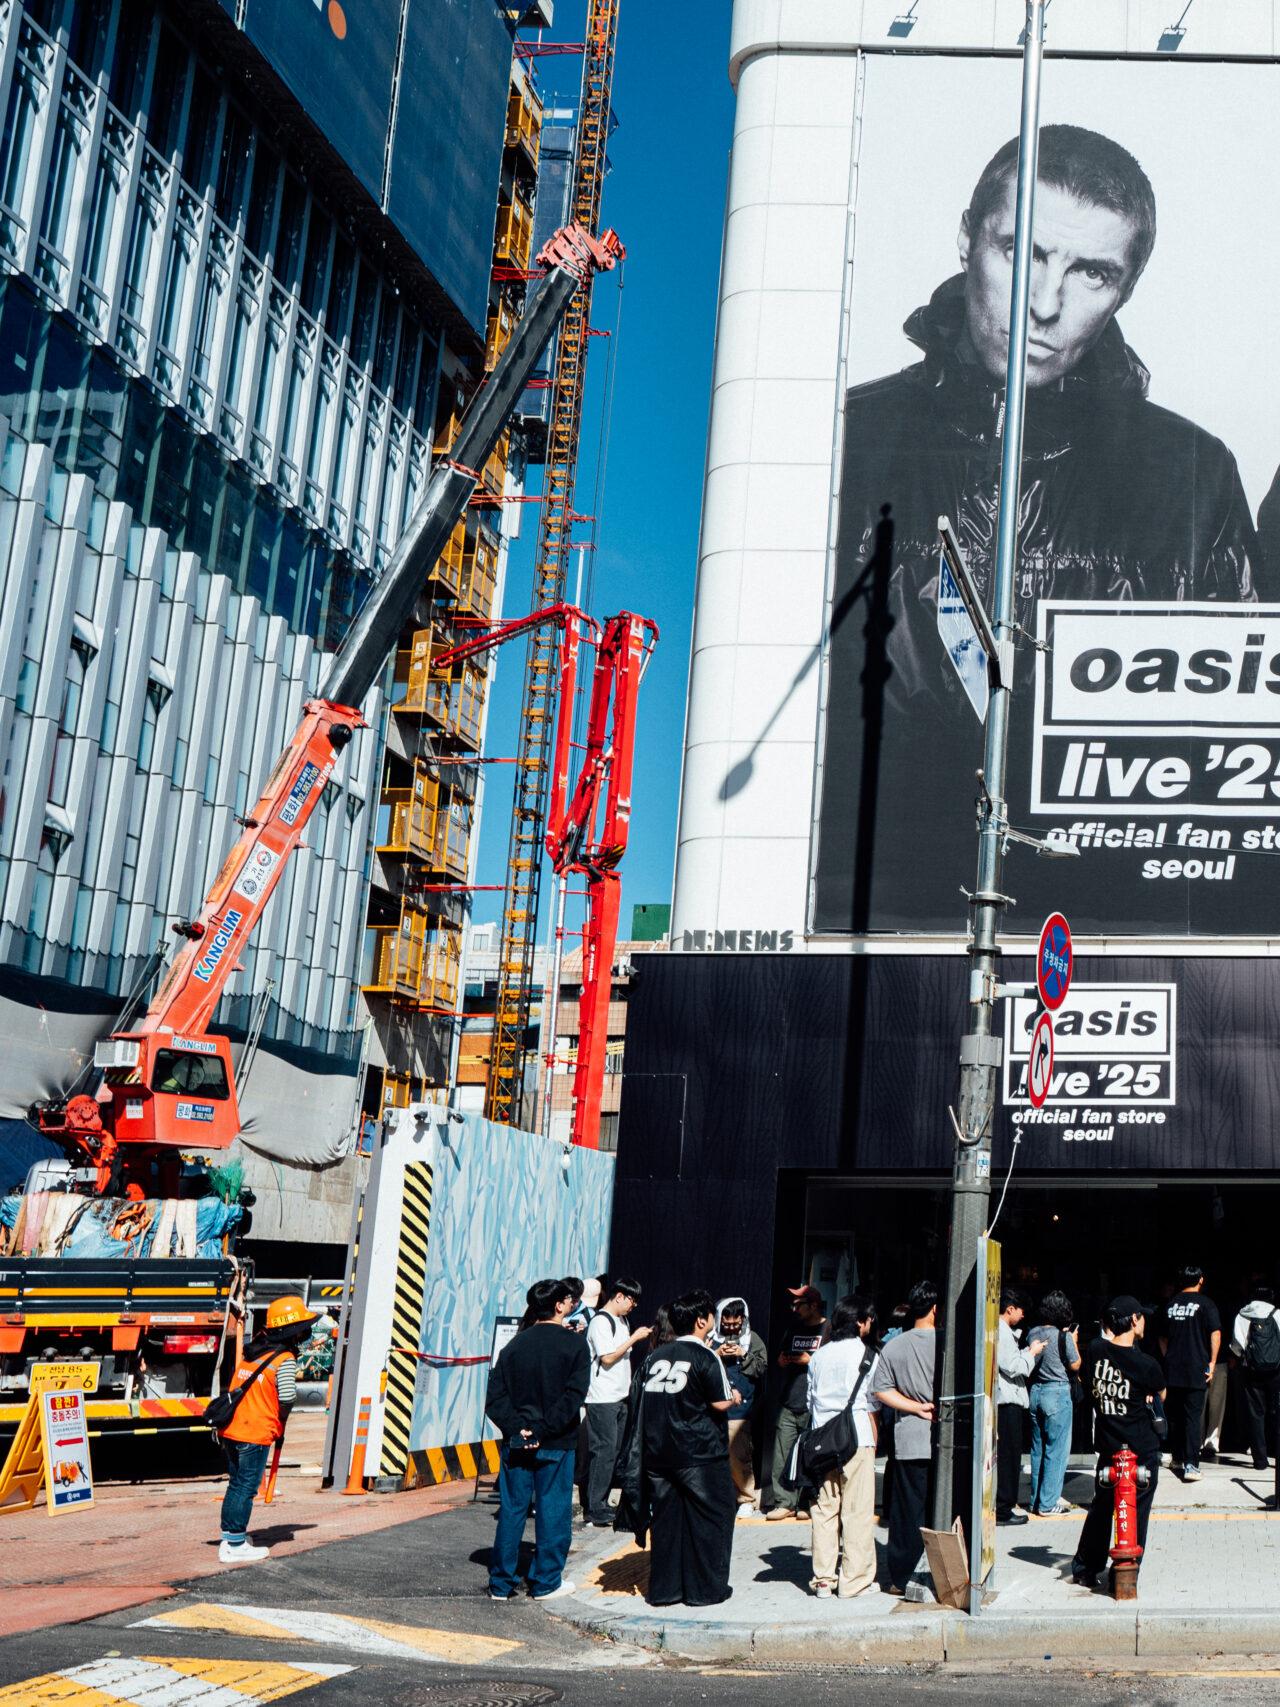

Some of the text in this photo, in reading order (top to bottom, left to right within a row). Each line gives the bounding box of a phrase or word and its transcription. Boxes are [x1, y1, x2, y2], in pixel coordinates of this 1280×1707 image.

[1057, 742, 1192, 799] live
[1047, 822, 1164, 848] official
[1176, 823, 1231, 849] fan
[1142, 855, 1236, 881] seoul
[193, 909, 242, 983] KANGLIM
[1017, 1064, 1090, 1096] lve
[1012, 1109, 1166, 1124] official fan store
[1063, 1126, 1114, 1141] seoul
[794, 1339, 818, 1347] oasis
[645, 1359, 692, 1393] 25
[1095, 1359, 1123, 1383] the
[1118, 1499, 1128, 1532] 소화전
